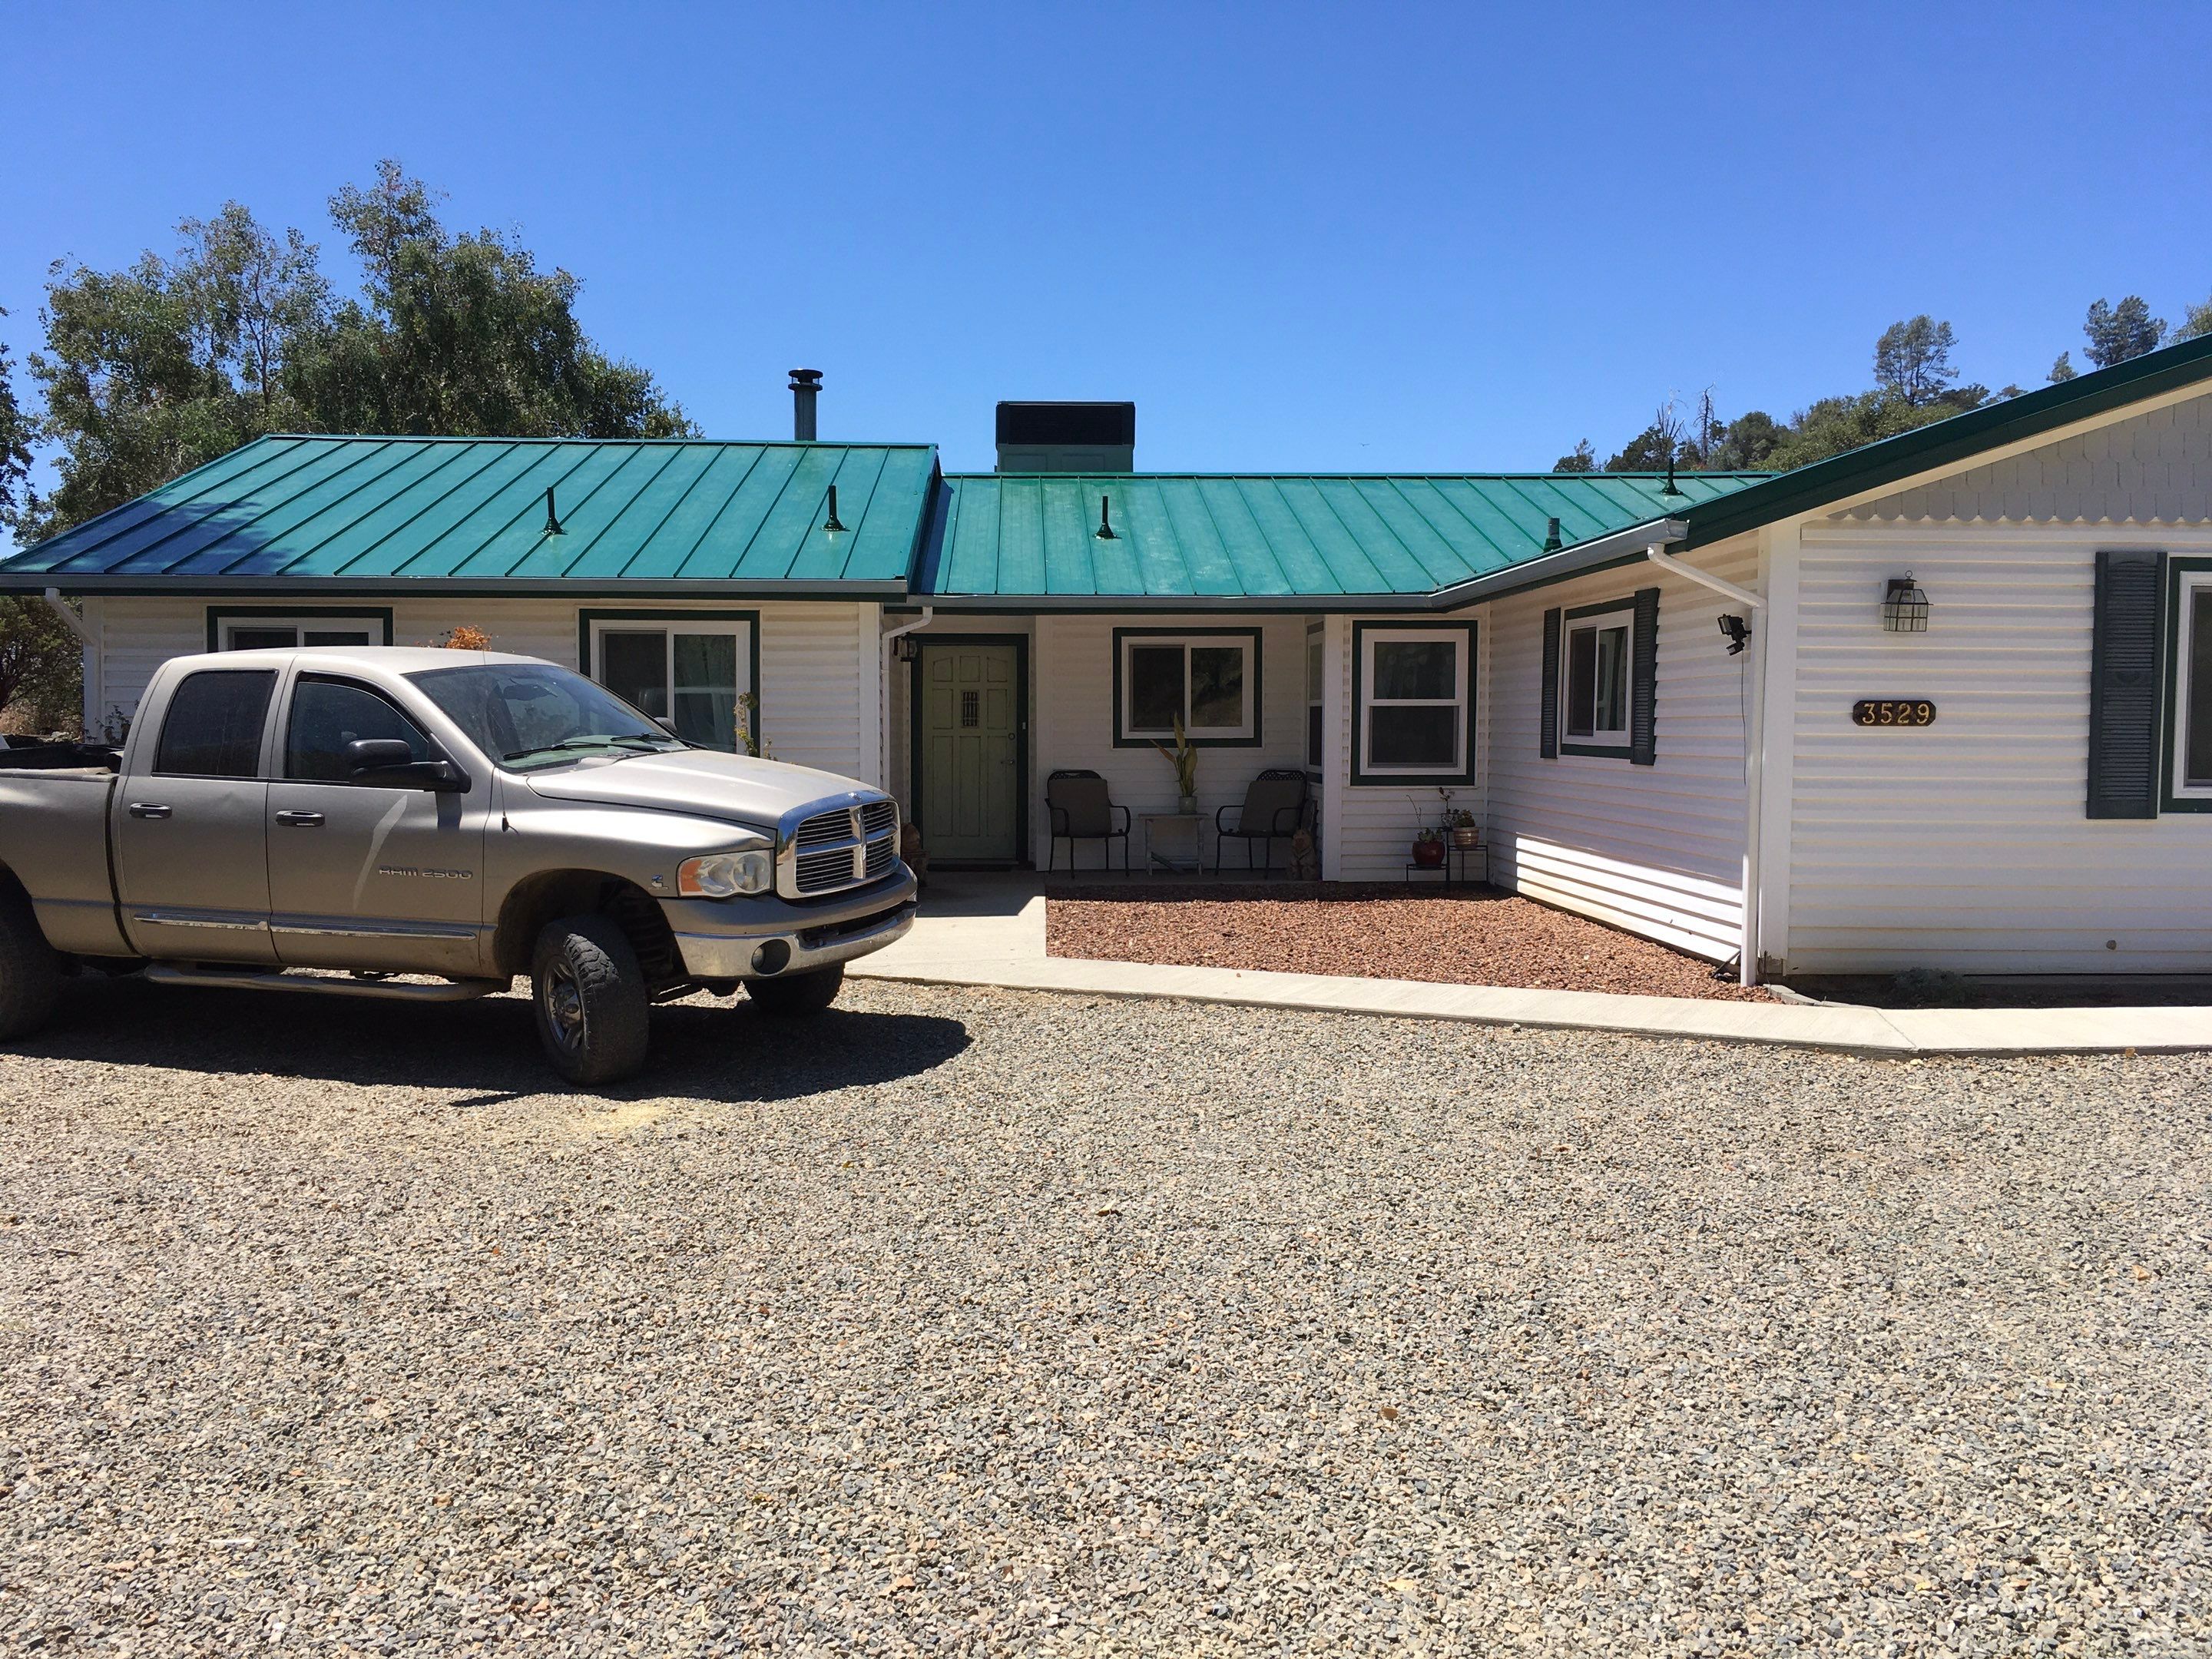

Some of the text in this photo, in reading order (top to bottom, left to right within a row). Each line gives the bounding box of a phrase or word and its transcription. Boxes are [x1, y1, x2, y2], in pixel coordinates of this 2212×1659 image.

[1862, 703, 1929, 724] 3529
[379, 865, 473, 879] RAM 2500
